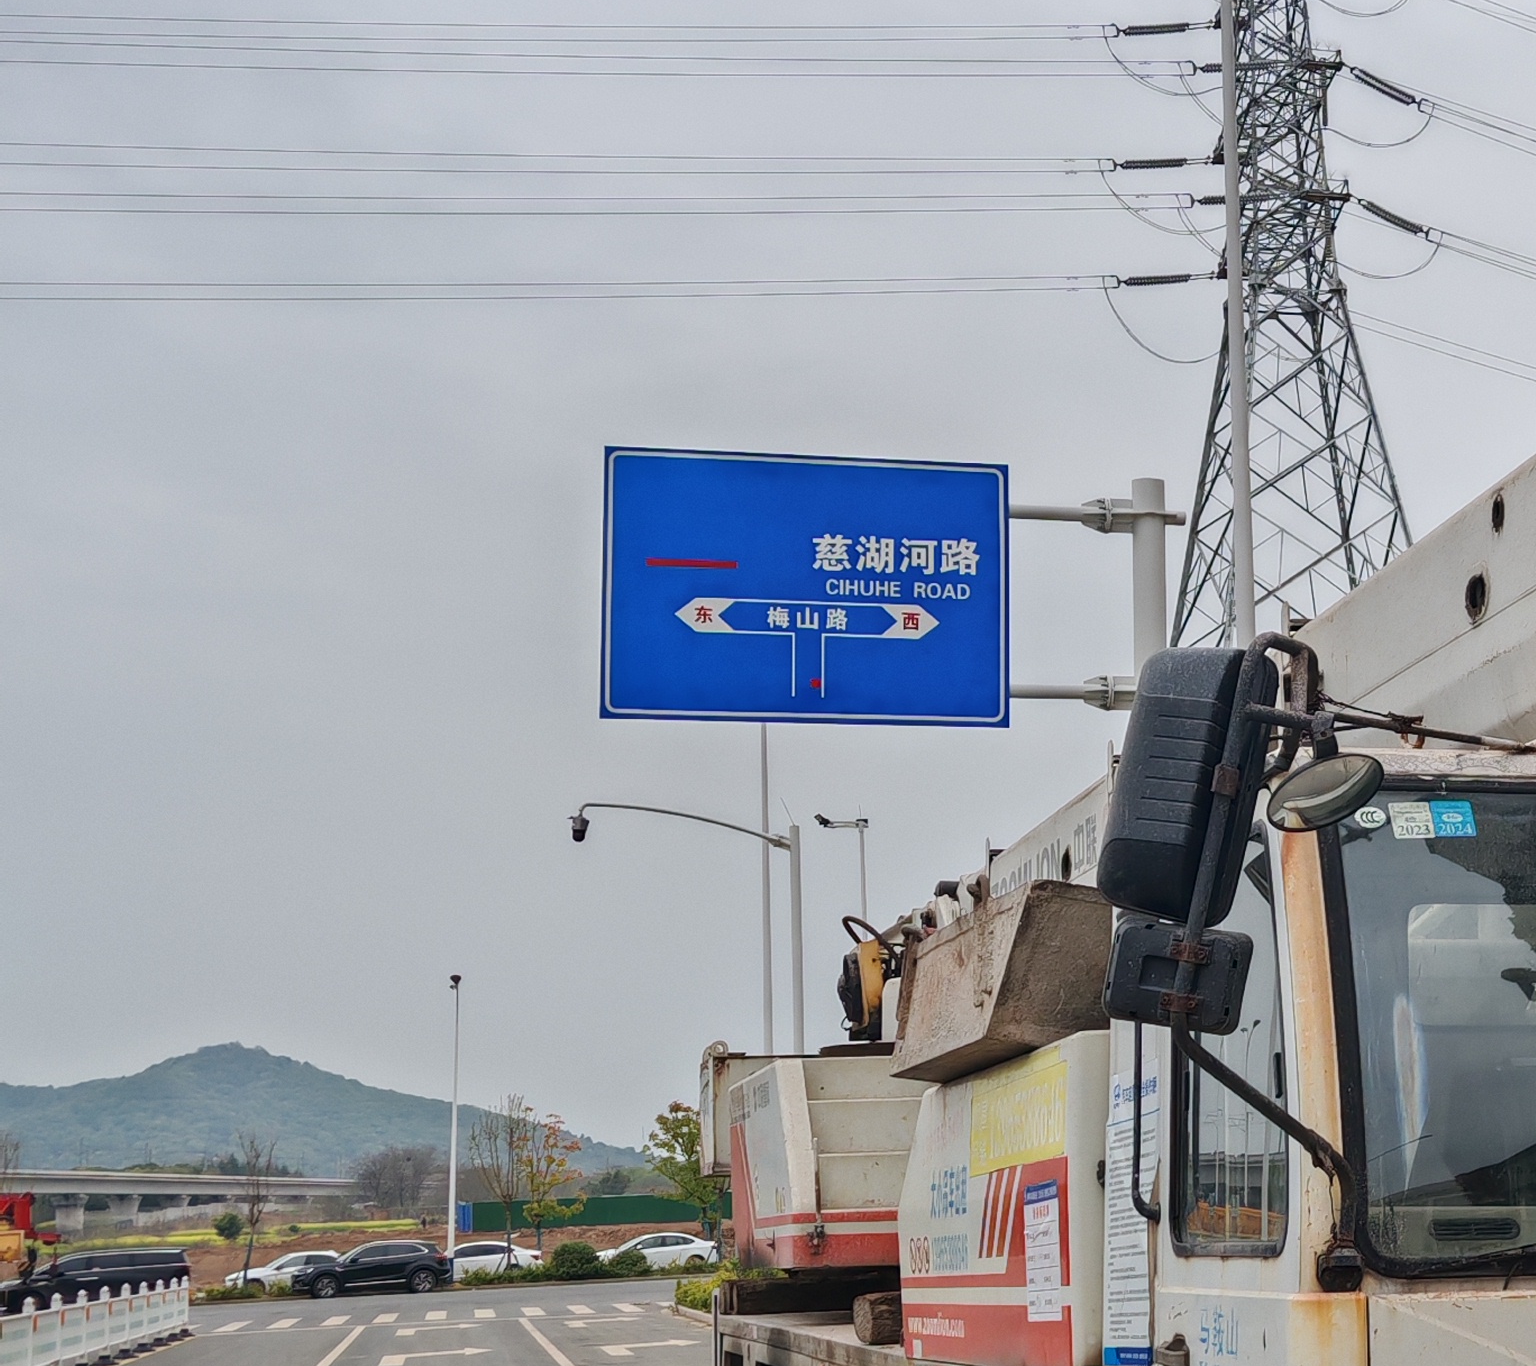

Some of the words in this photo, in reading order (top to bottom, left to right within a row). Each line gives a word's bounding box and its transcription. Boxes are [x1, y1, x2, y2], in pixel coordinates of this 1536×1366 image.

[812, 533, 980, 576] 慈湖河路
[826, 578, 901, 598] CIHUHE
[913, 582, 971, 600] ROAD
[695, 605, 713, 624] 东
[767, 606, 849, 631] 梅山路
[902, 612, 920, 631] 西
[1397, 824, 1431, 836] 2023
[1438, 823, 1473, 835] 2024
[1073, 813, 1098, 873] 中联
[1199, 1305, 1239, 1359] 马鞍山
